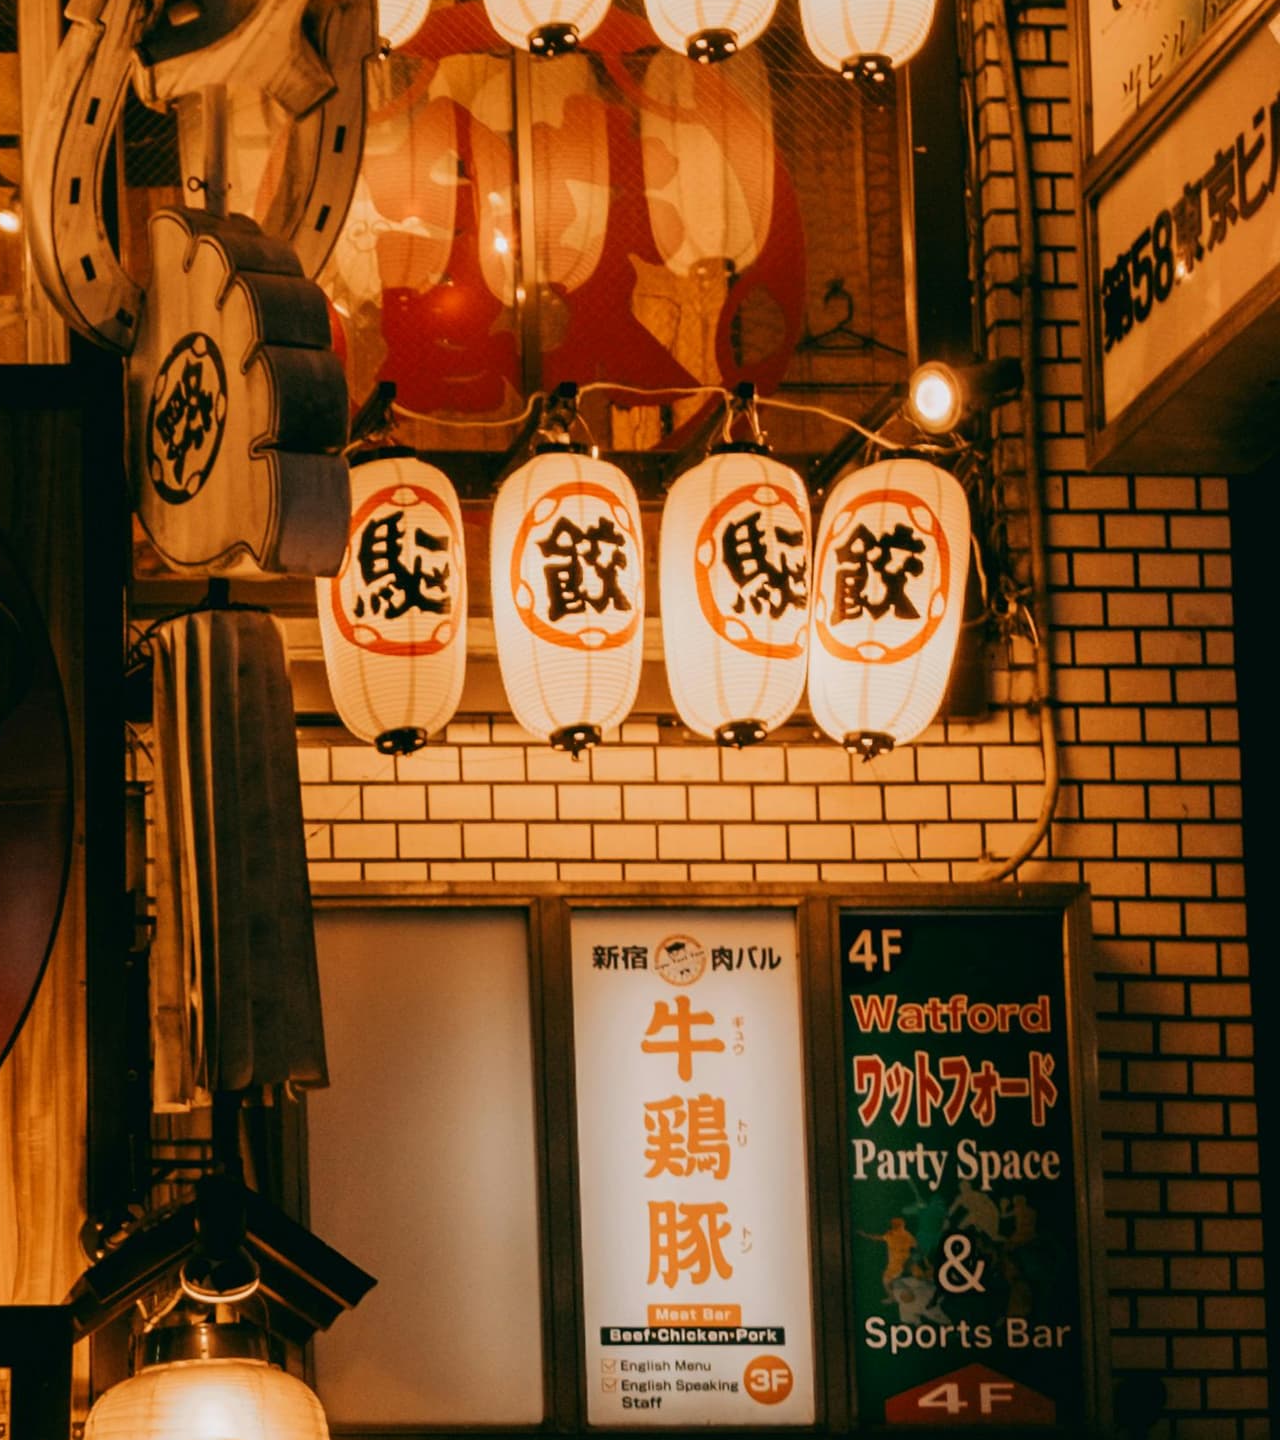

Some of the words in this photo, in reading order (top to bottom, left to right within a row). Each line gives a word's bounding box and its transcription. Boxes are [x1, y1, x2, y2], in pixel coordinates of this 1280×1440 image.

[591, 944, 649, 971] 新宿
[711, 945, 783, 972] 肉バル
[848, 929, 904, 974] 4F
[849, 994, 1051, 1034] Watford
[852, 1049, 1059, 1130] ワットフォード
[641, 994, 734, 1290] 牛鶏豚
[851, 1136, 948, 1194] Party
[956, 1136, 1061, 1192] Space
[937, 1233, 986, 1294] &
[655, 1306, 699, 1322] Meat
[702, 1306, 733, 1322] Bar
[864, 1316, 992, 1355] Sports
[1005, 1316, 1072, 1352] Bar
[620, 1359, 672, 1374] English
[675, 1359, 712, 1373] Menu
[749, 1369, 791, 1392] 3F
[621, 1378, 674, 1394] English
[676, 1378, 739, 1394] Speaking
[621, 1394, 663, 1411] Staff
[916, 1382, 1016, 1415] 4F
